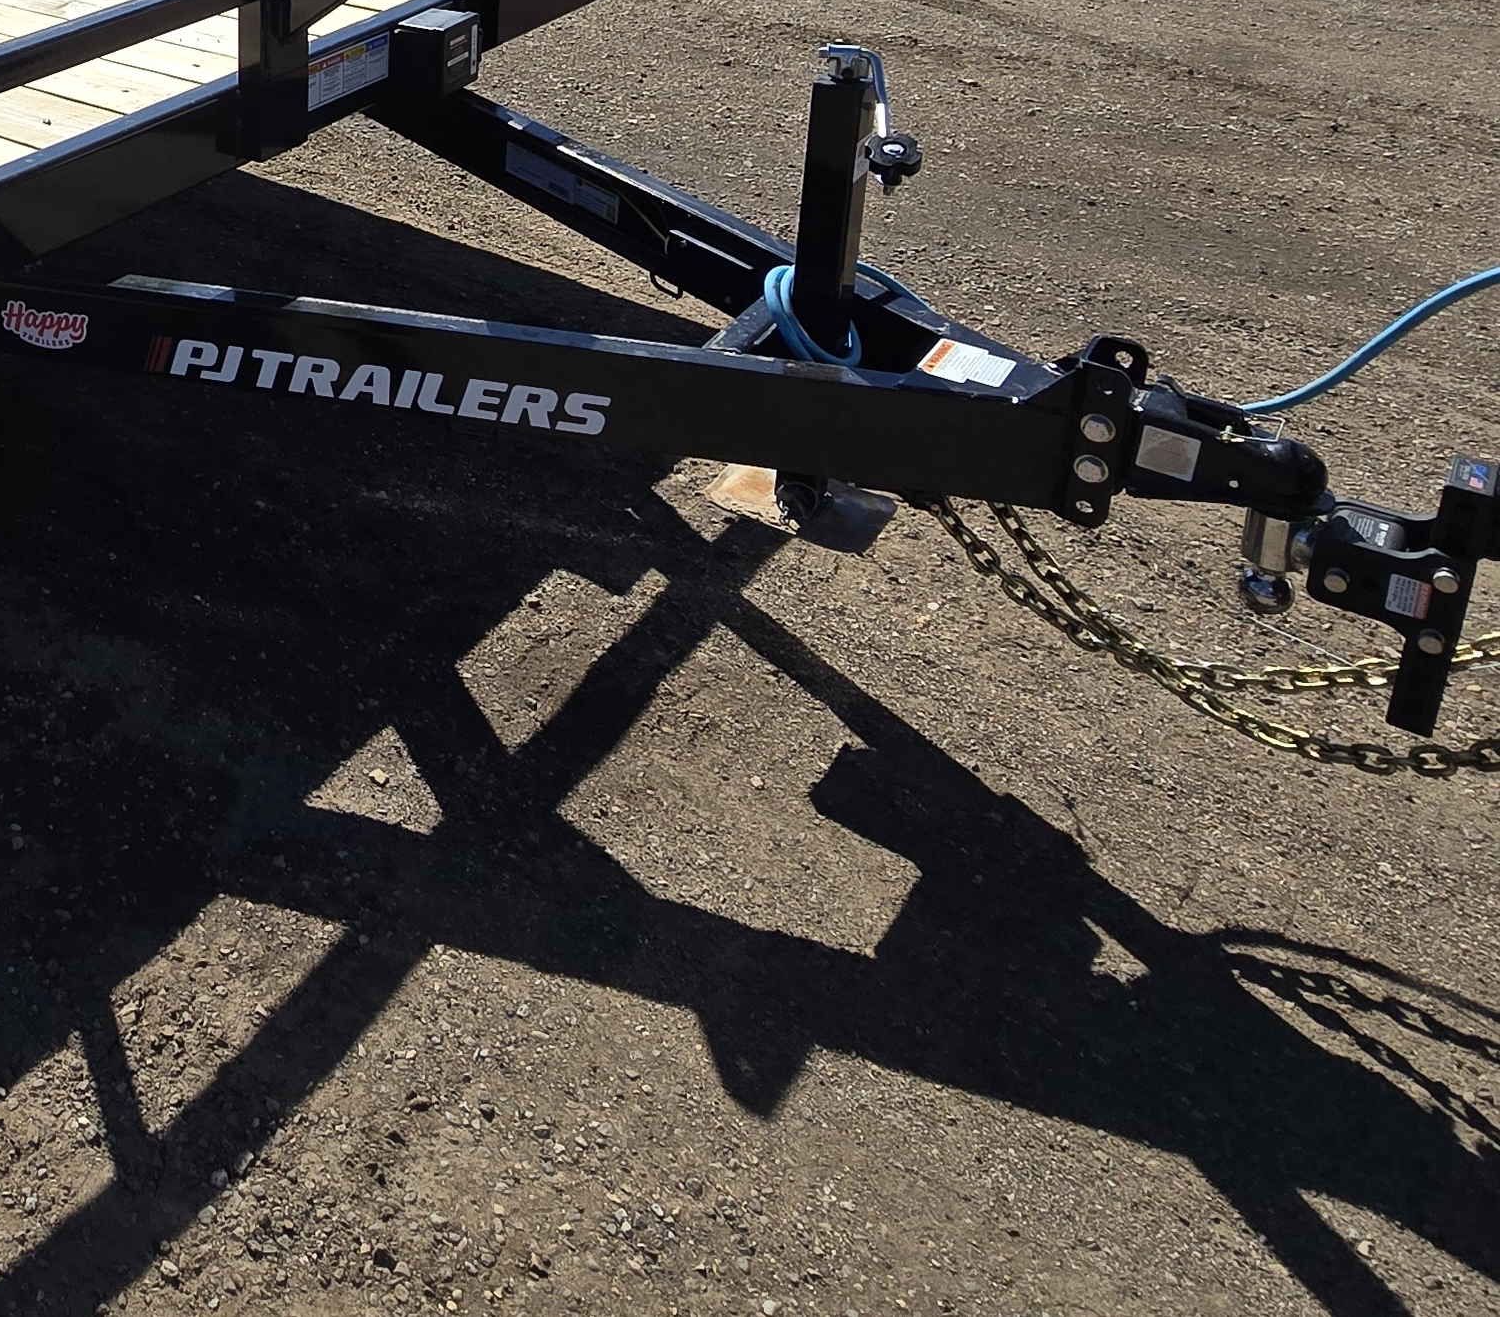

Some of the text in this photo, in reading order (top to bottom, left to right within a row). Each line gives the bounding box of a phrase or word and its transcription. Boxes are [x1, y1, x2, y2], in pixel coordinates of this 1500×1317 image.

[3, 302, 87, 341] Happy
[22, 331, 70, 347] TRAILERS
[170, 339, 612, 435] PJ TRAILERS
